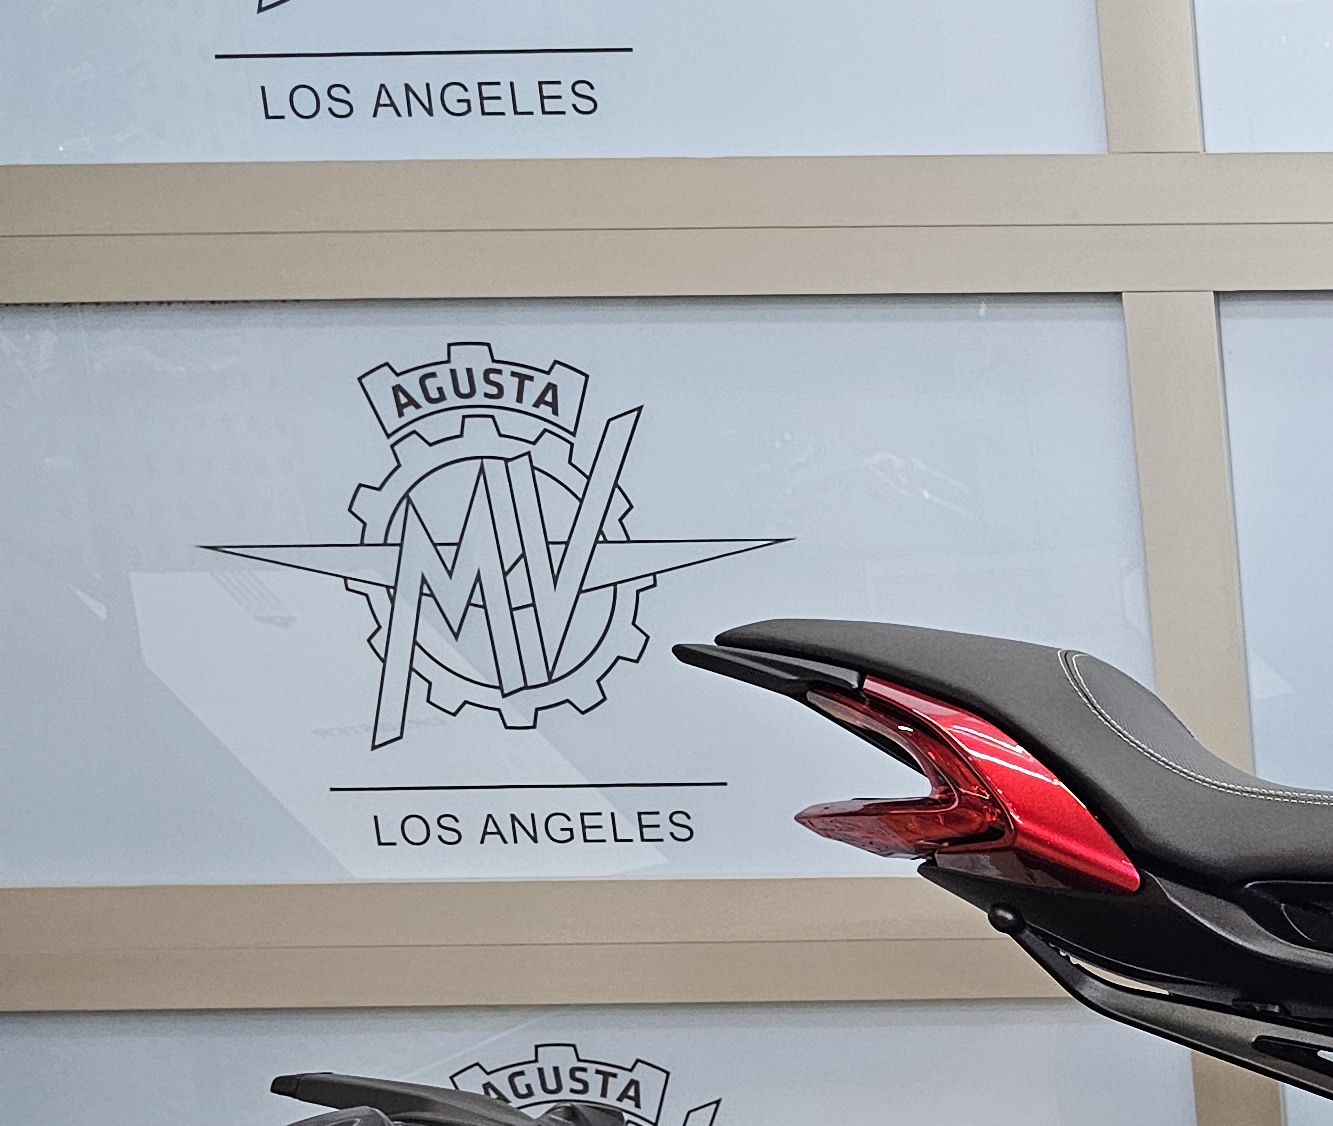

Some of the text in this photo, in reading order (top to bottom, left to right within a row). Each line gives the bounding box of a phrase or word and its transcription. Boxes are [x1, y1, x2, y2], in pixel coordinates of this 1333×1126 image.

[261, 79, 597, 119] LOS ANGELES
[391, 367, 560, 417] AGUSTA
[374, 810, 693, 846] LOS ANGELES
[481, 1064, 642, 1110] AGUSTA
